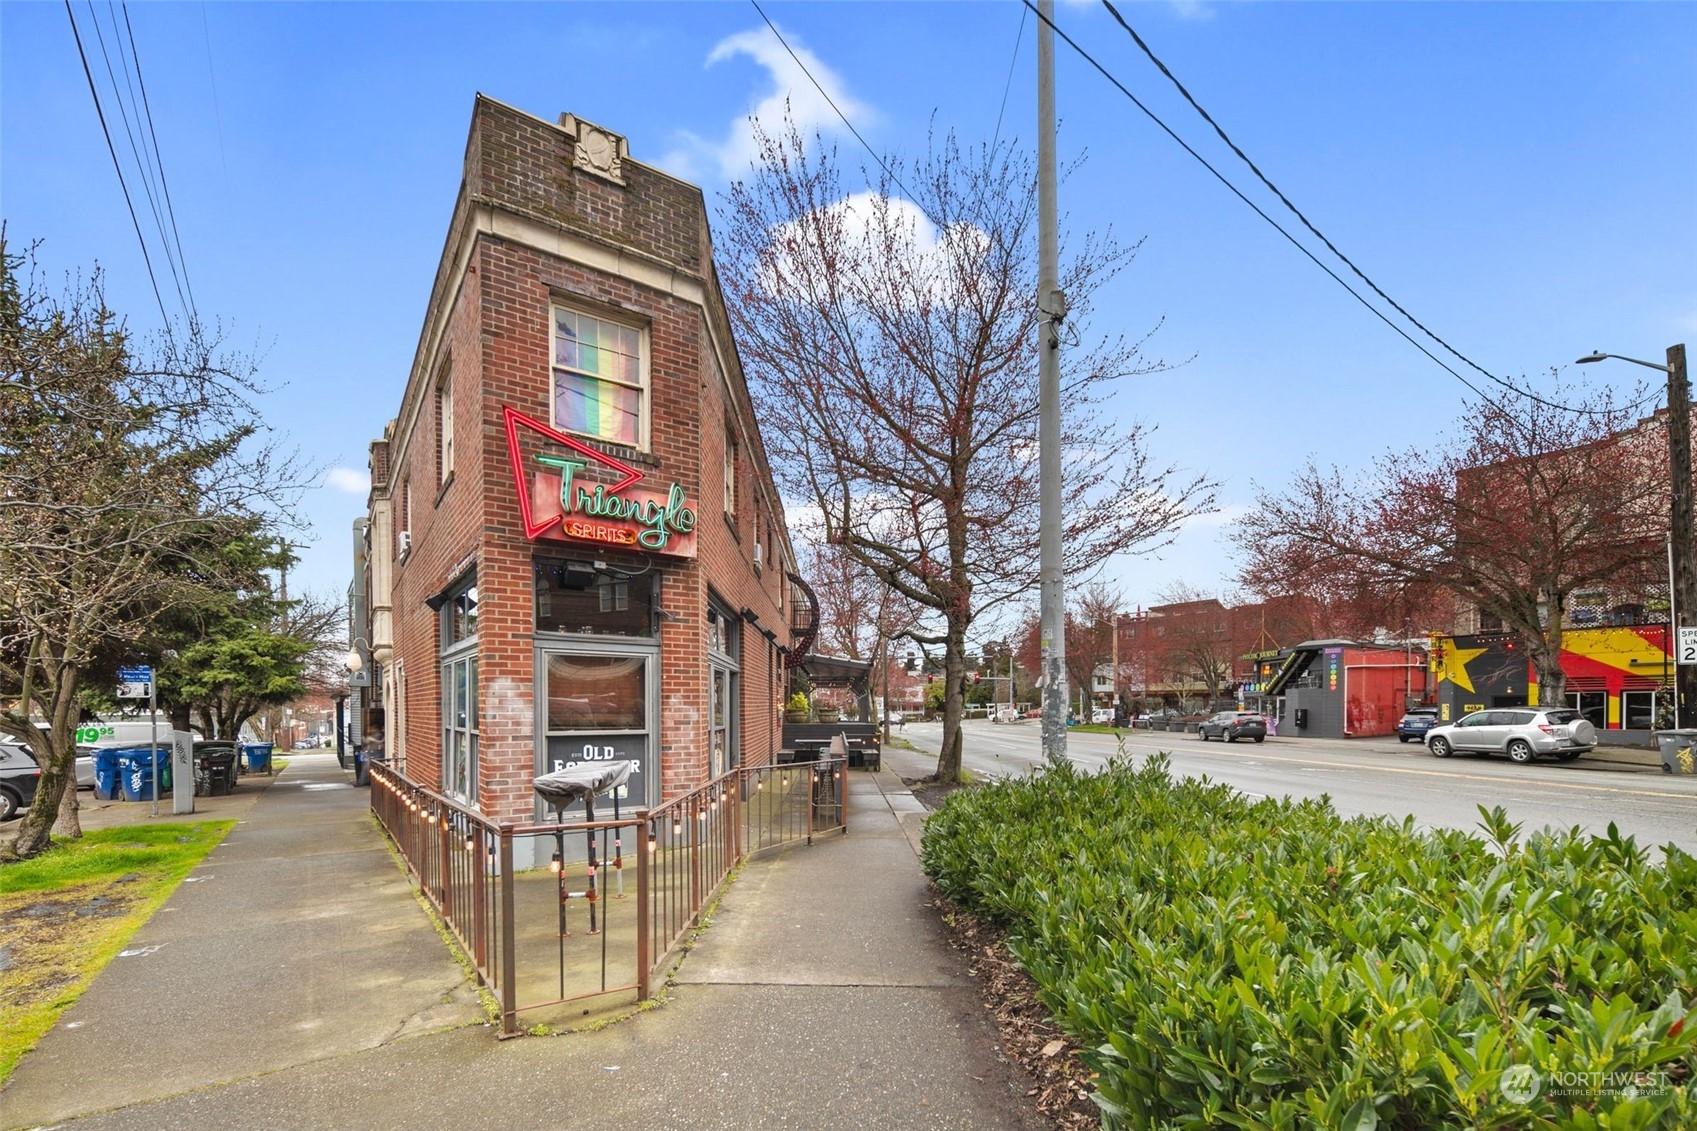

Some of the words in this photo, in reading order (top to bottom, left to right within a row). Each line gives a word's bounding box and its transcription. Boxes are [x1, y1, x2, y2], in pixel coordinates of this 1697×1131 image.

[533, 454, 696, 550] Triangle
[572, 522, 627, 542] SPIRITS
[583, 744, 615, 760] OLD
